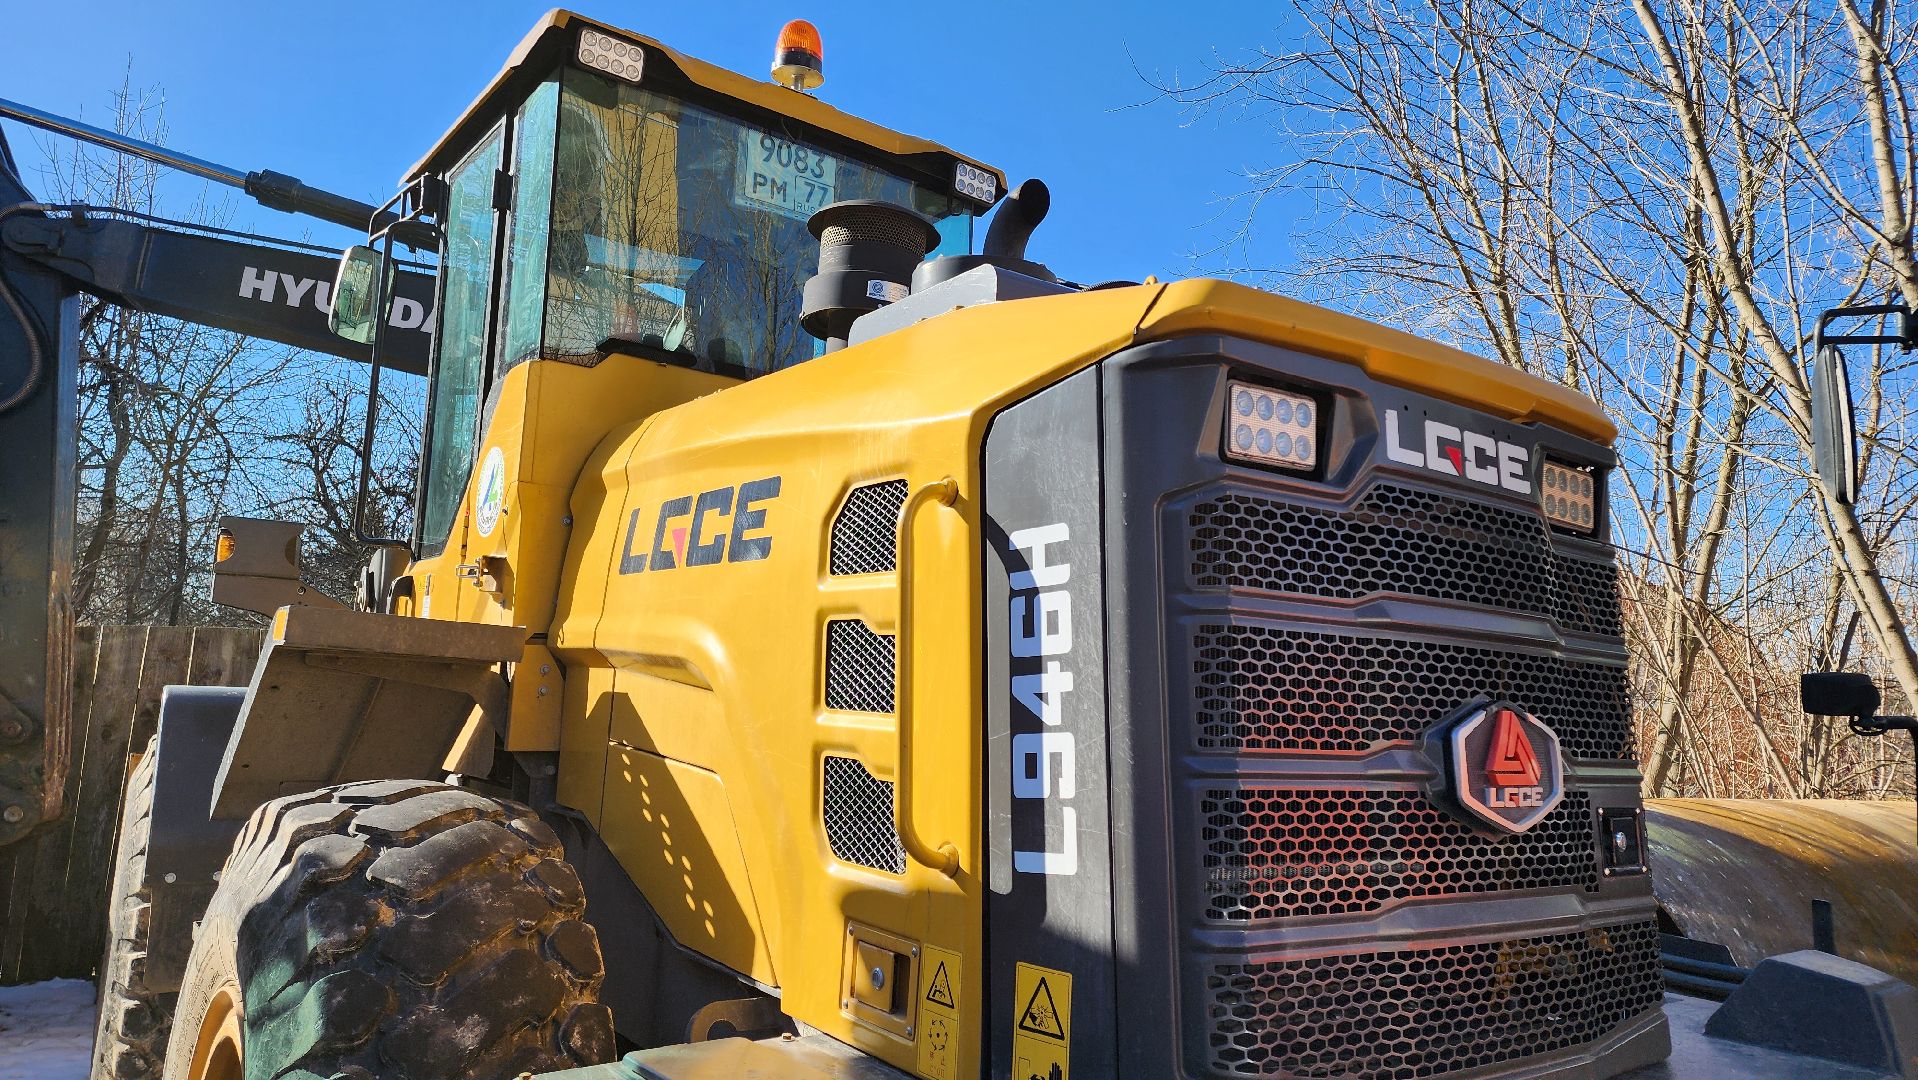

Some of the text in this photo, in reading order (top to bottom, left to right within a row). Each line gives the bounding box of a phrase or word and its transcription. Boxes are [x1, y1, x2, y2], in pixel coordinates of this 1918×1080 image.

[760, 133, 825, 179] 9083
[804, 181, 829, 207] 77
[1384, 409, 1532, 495] LGCE
[618, 475, 782, 576] LGCE
[1008, 522, 1078, 876] L946H
